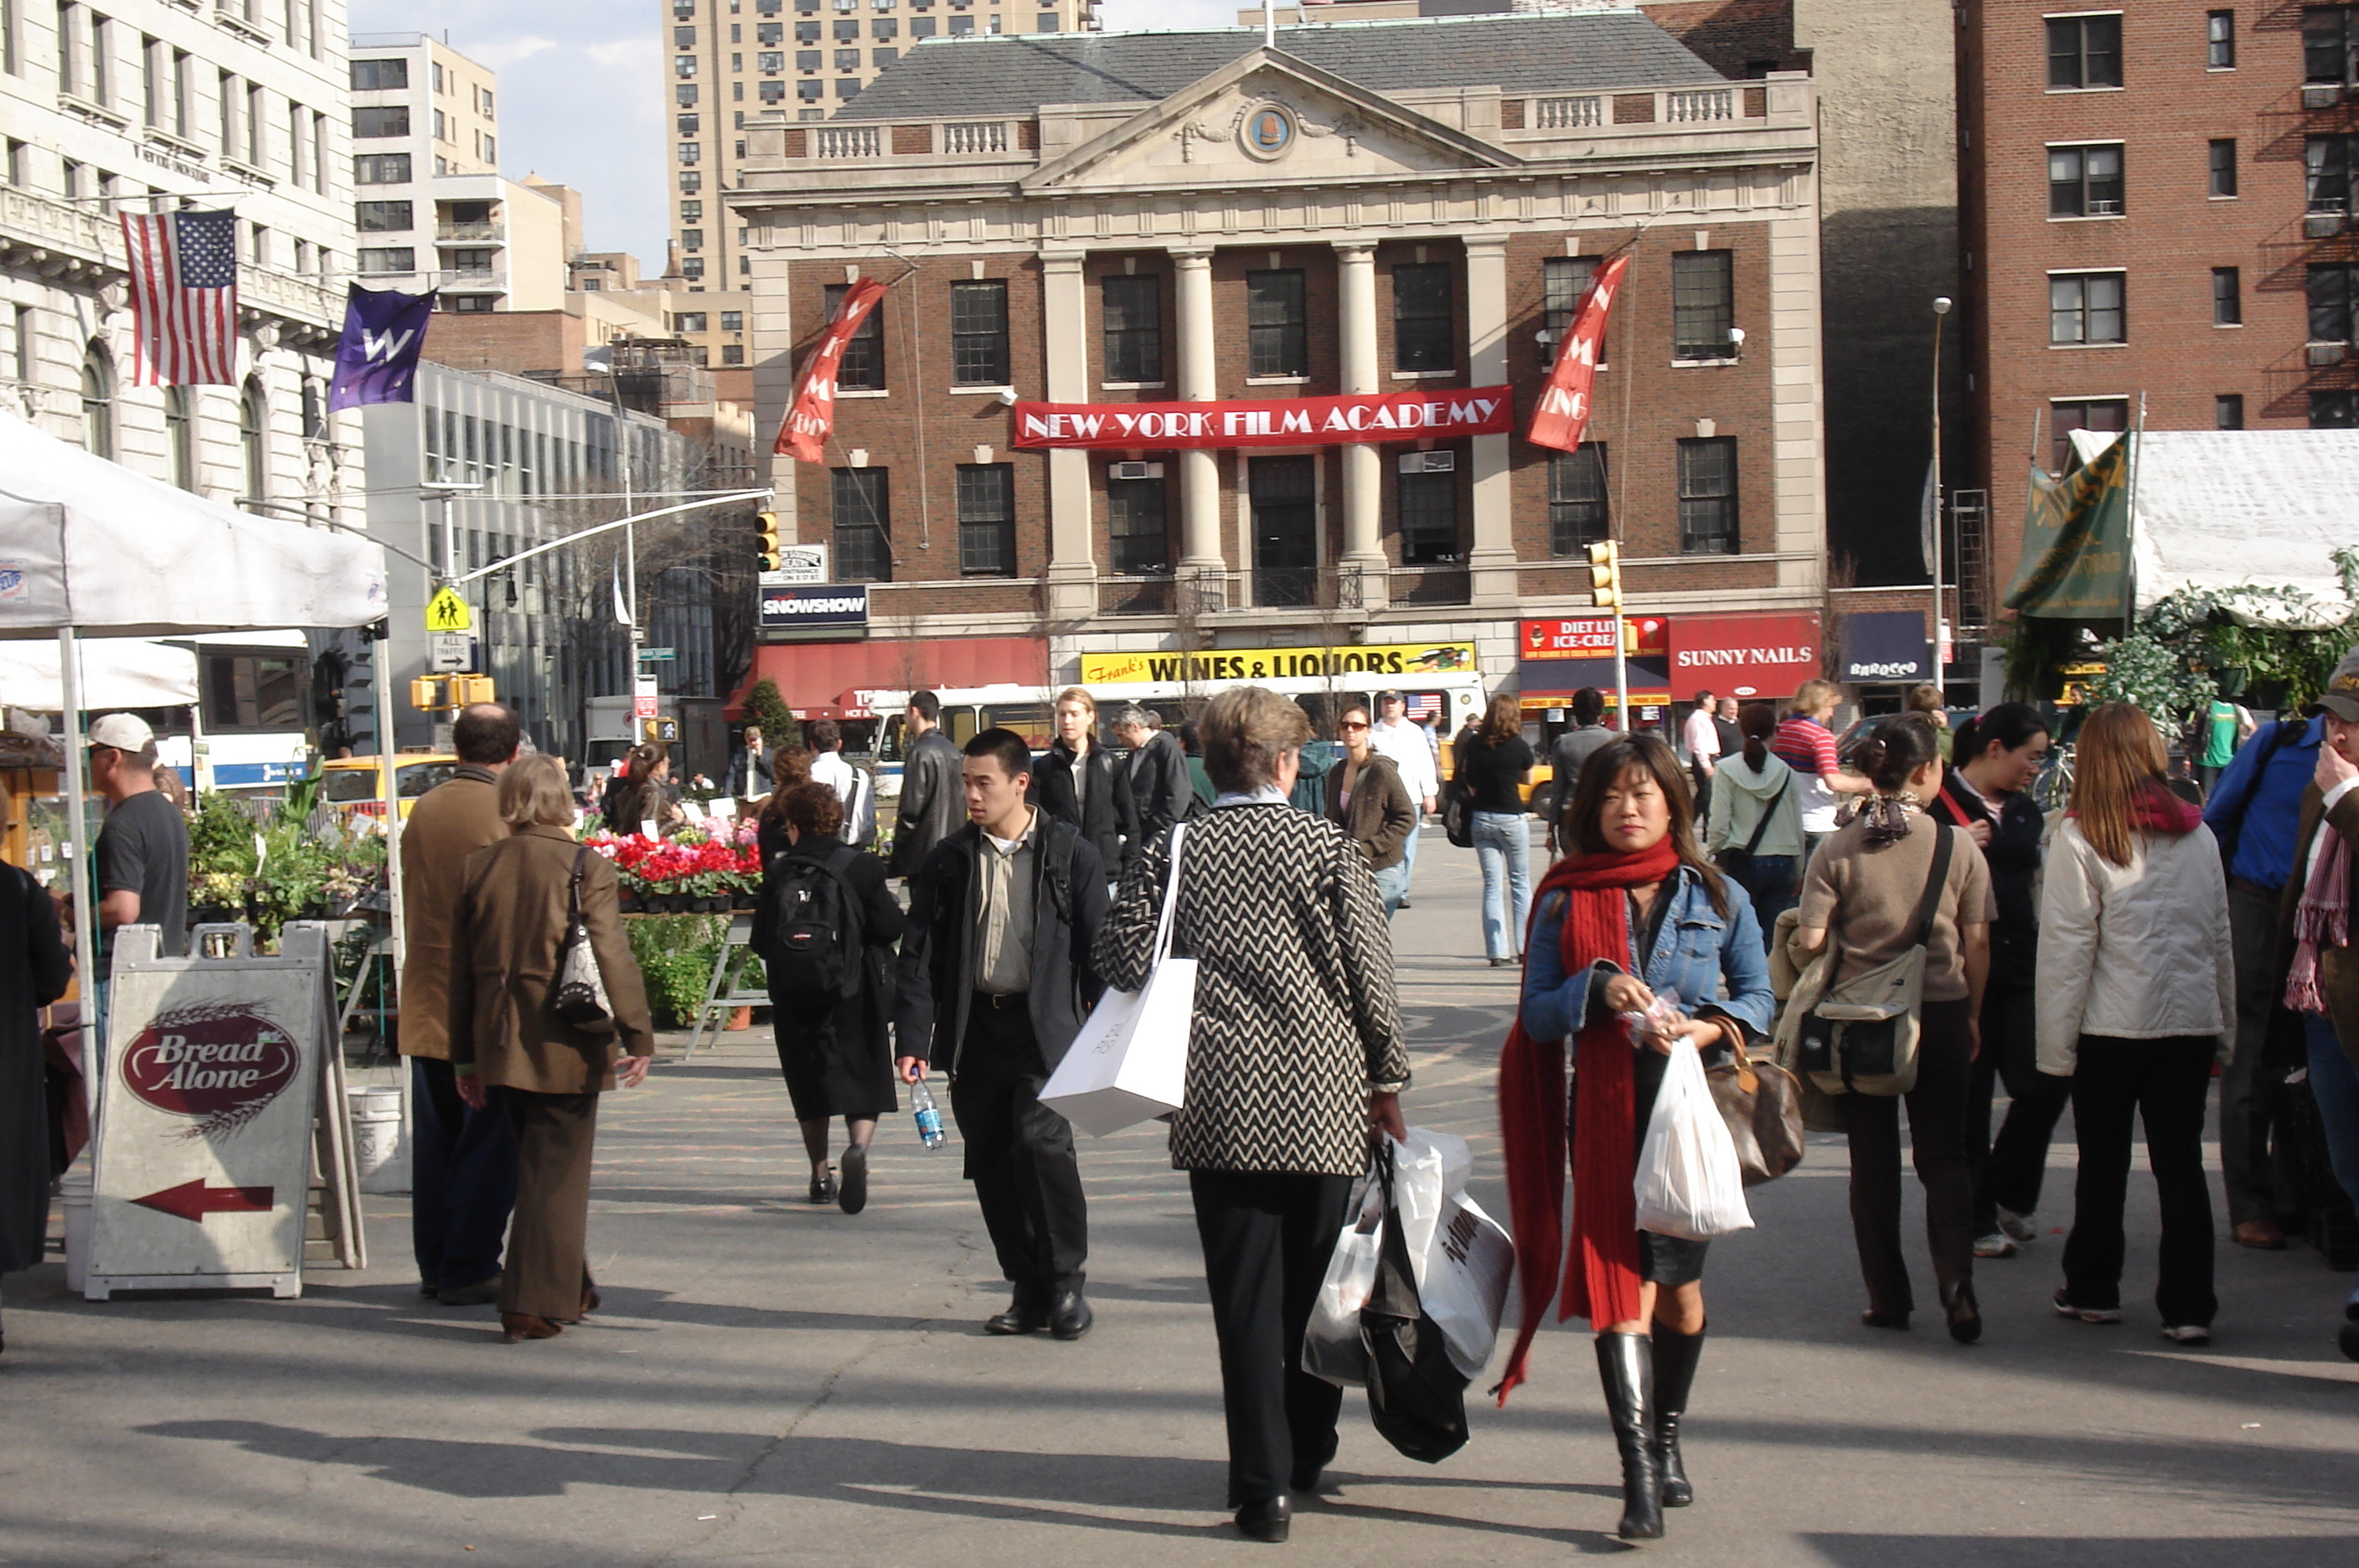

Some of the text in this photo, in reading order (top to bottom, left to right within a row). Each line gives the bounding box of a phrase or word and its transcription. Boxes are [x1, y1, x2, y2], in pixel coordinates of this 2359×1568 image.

[363, 328, 416, 362] W
[1025, 398, 1501, 439] NEW YORK FILM ACADEMY
[763, 597, 865, 615] SNOWSHOW
[1561, 621, 1594, 634] DIET
[1087, 658, 1144, 683] Frank's
[1149, 656, 1245, 682] WINES
[1251, 661, 1267, 678] &
[1678, 649, 1747, 667] SUNNY
[1751, 647, 1813, 663] NAILS
[844, 709, 861, 718] HOT
[153, 1034, 265, 1064] Bread
[147, 1062, 261, 1091] Alone
